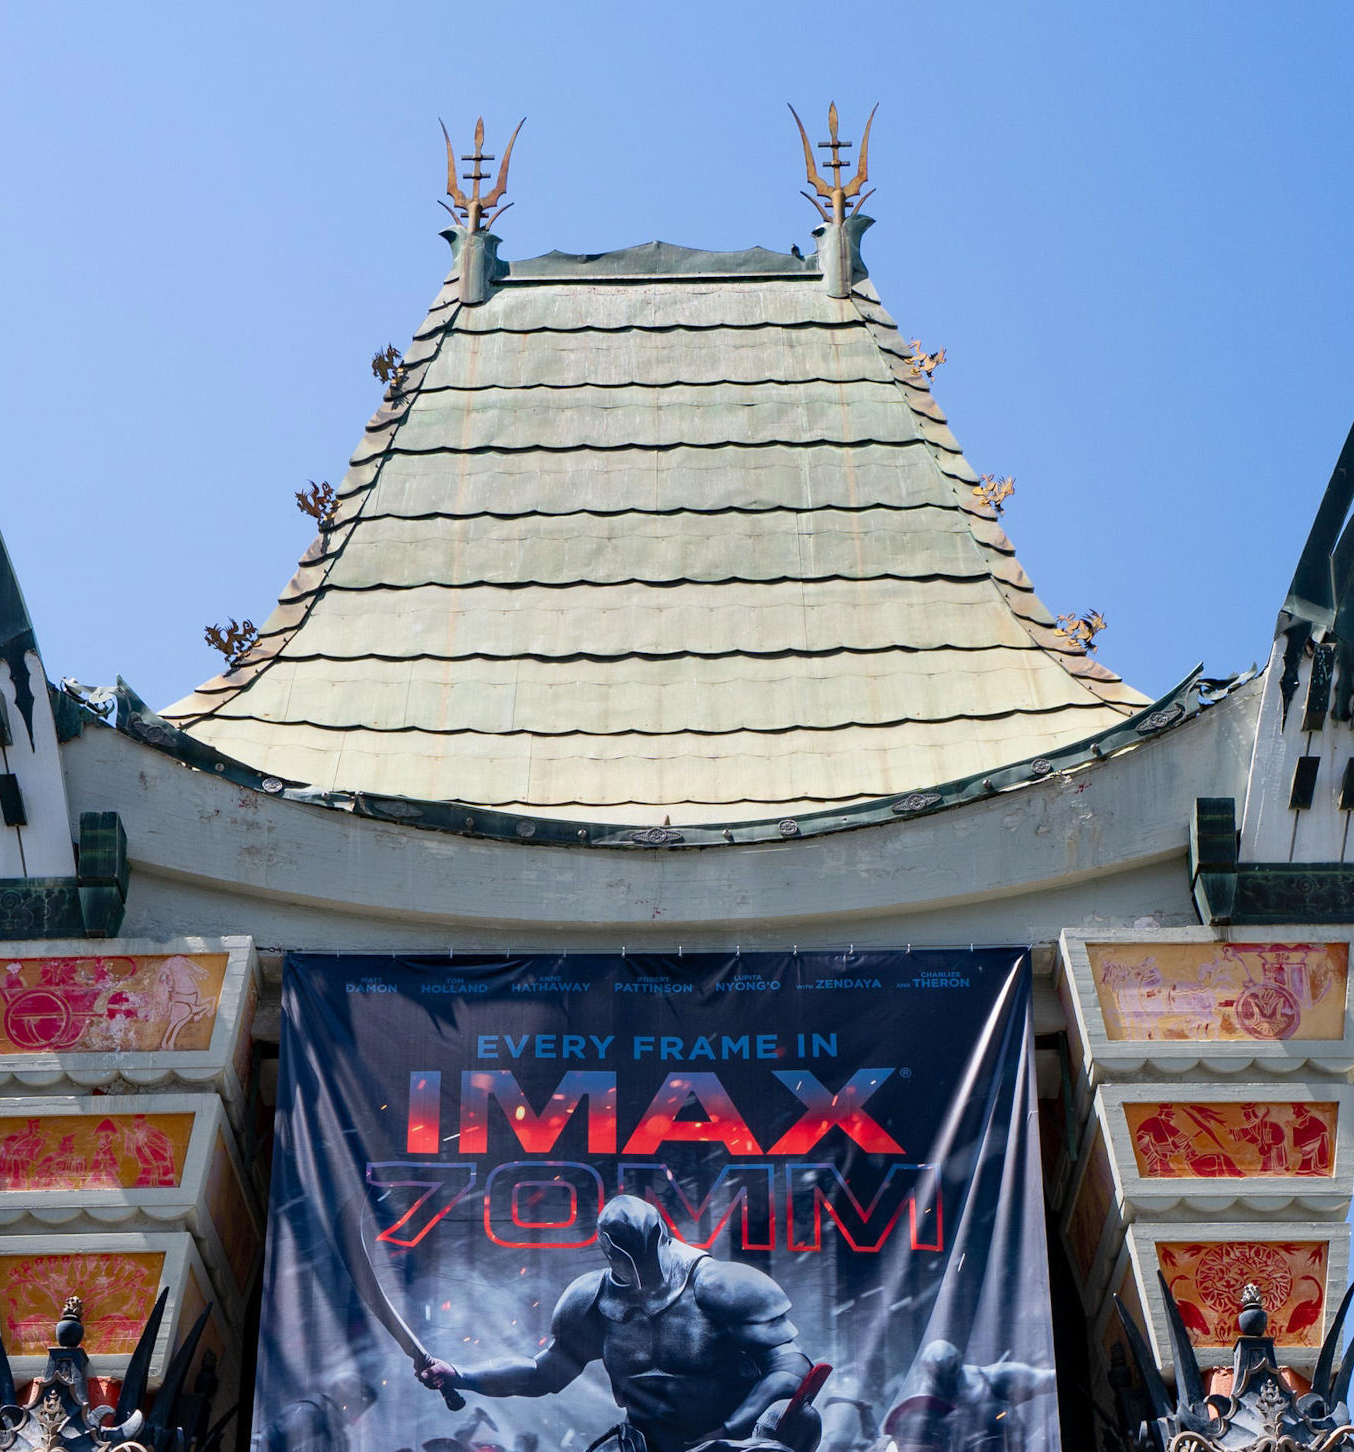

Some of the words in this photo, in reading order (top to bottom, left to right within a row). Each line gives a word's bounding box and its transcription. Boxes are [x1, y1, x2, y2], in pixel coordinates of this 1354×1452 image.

[511, 982, 592, 993] HATHAWAY
[614, 982, 694, 993] PATTINSON
[715, 980, 782, 992] NYONG'O
[815, 978, 883, 989] ZENDAYA
[912, 977, 971, 988] THERON
[345, 983, 398, 994] DAMON
[421, 983, 489, 994] HOLLAND
[477, 1034, 615, 1059] EVERY
[633, 1035, 779, 1060] FRAME
[797, 1033, 838, 1058] IN
[365, 1159, 945, 1253] 70MM
